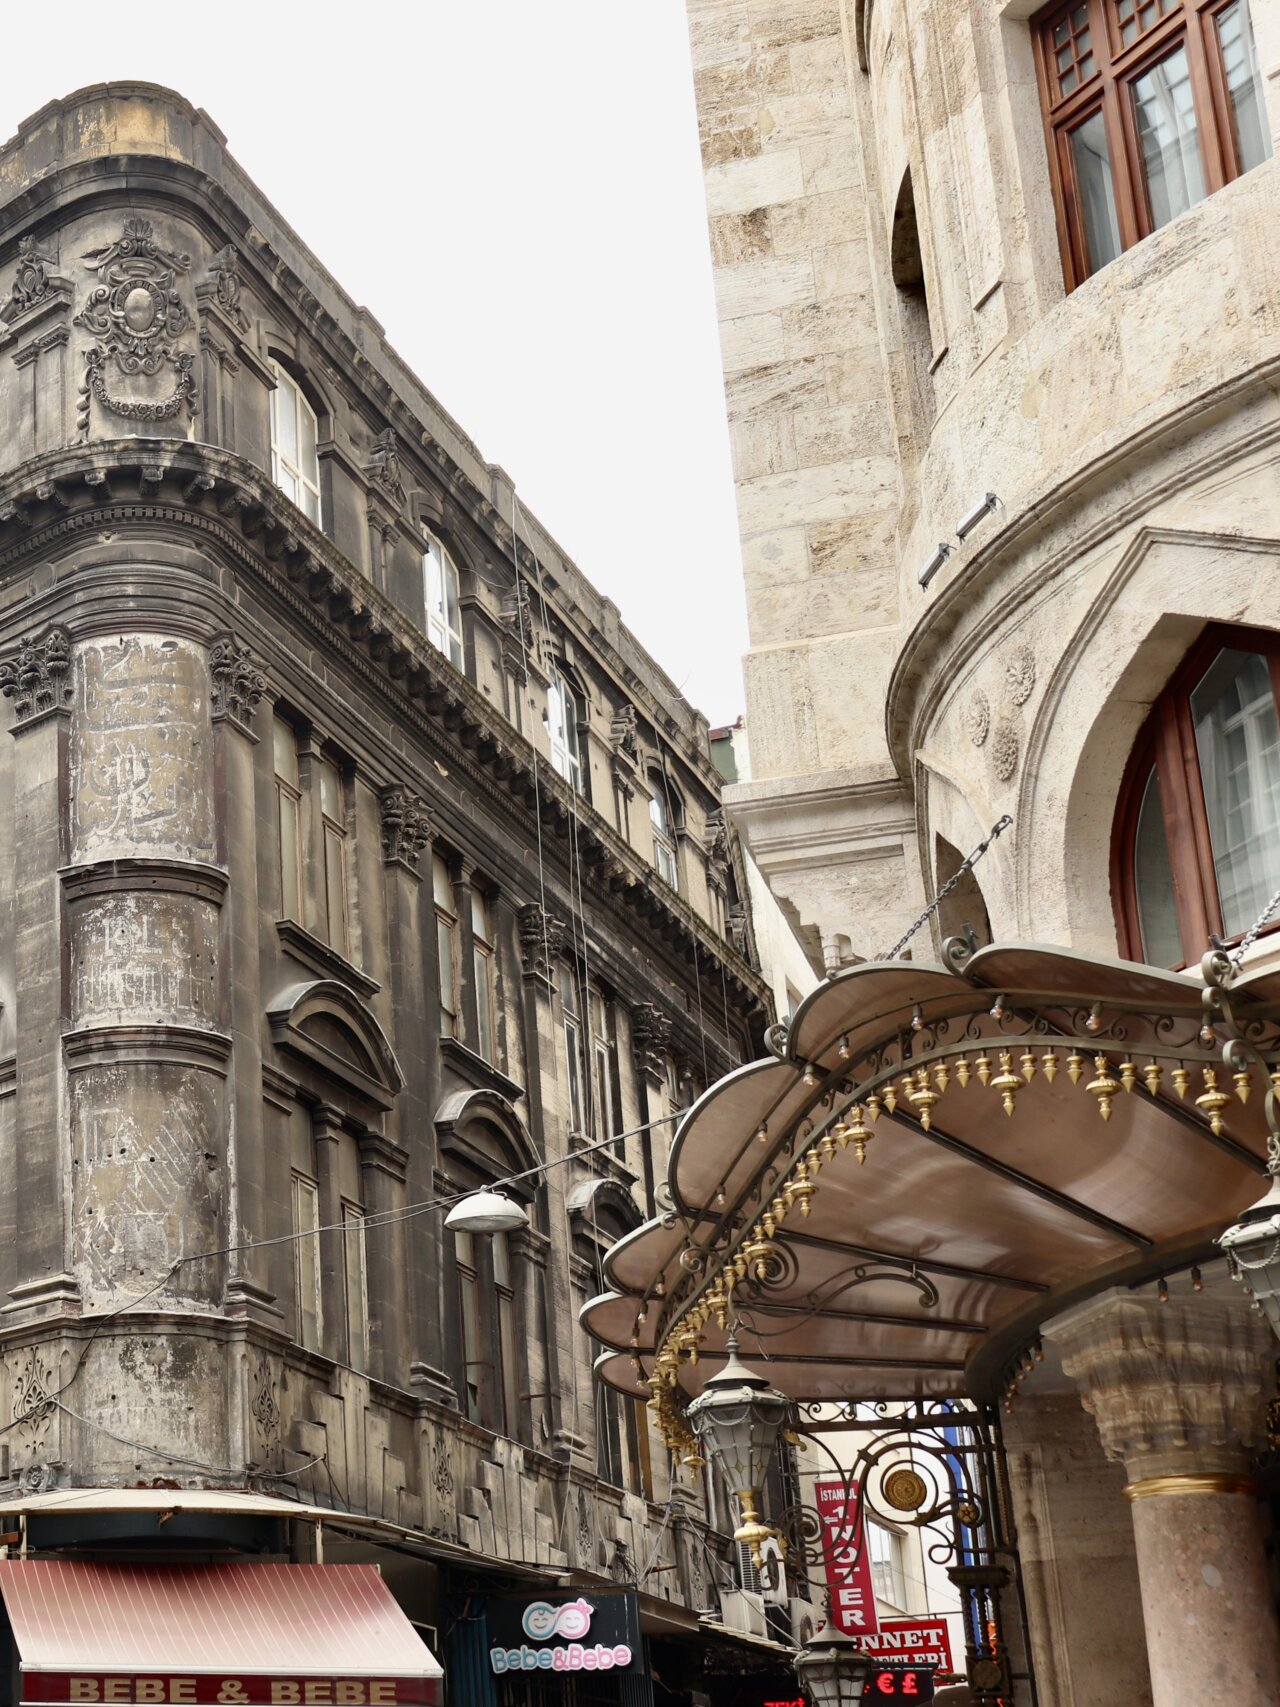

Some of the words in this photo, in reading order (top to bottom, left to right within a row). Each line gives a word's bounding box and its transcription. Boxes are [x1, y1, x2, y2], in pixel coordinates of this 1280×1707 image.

[831, 1524, 866, 1627] NOTER
[69, 1678, 197, 1703] BEBE
[217, 1679, 250, 1704] &
[270, 1680, 398, 1705] BEBE
